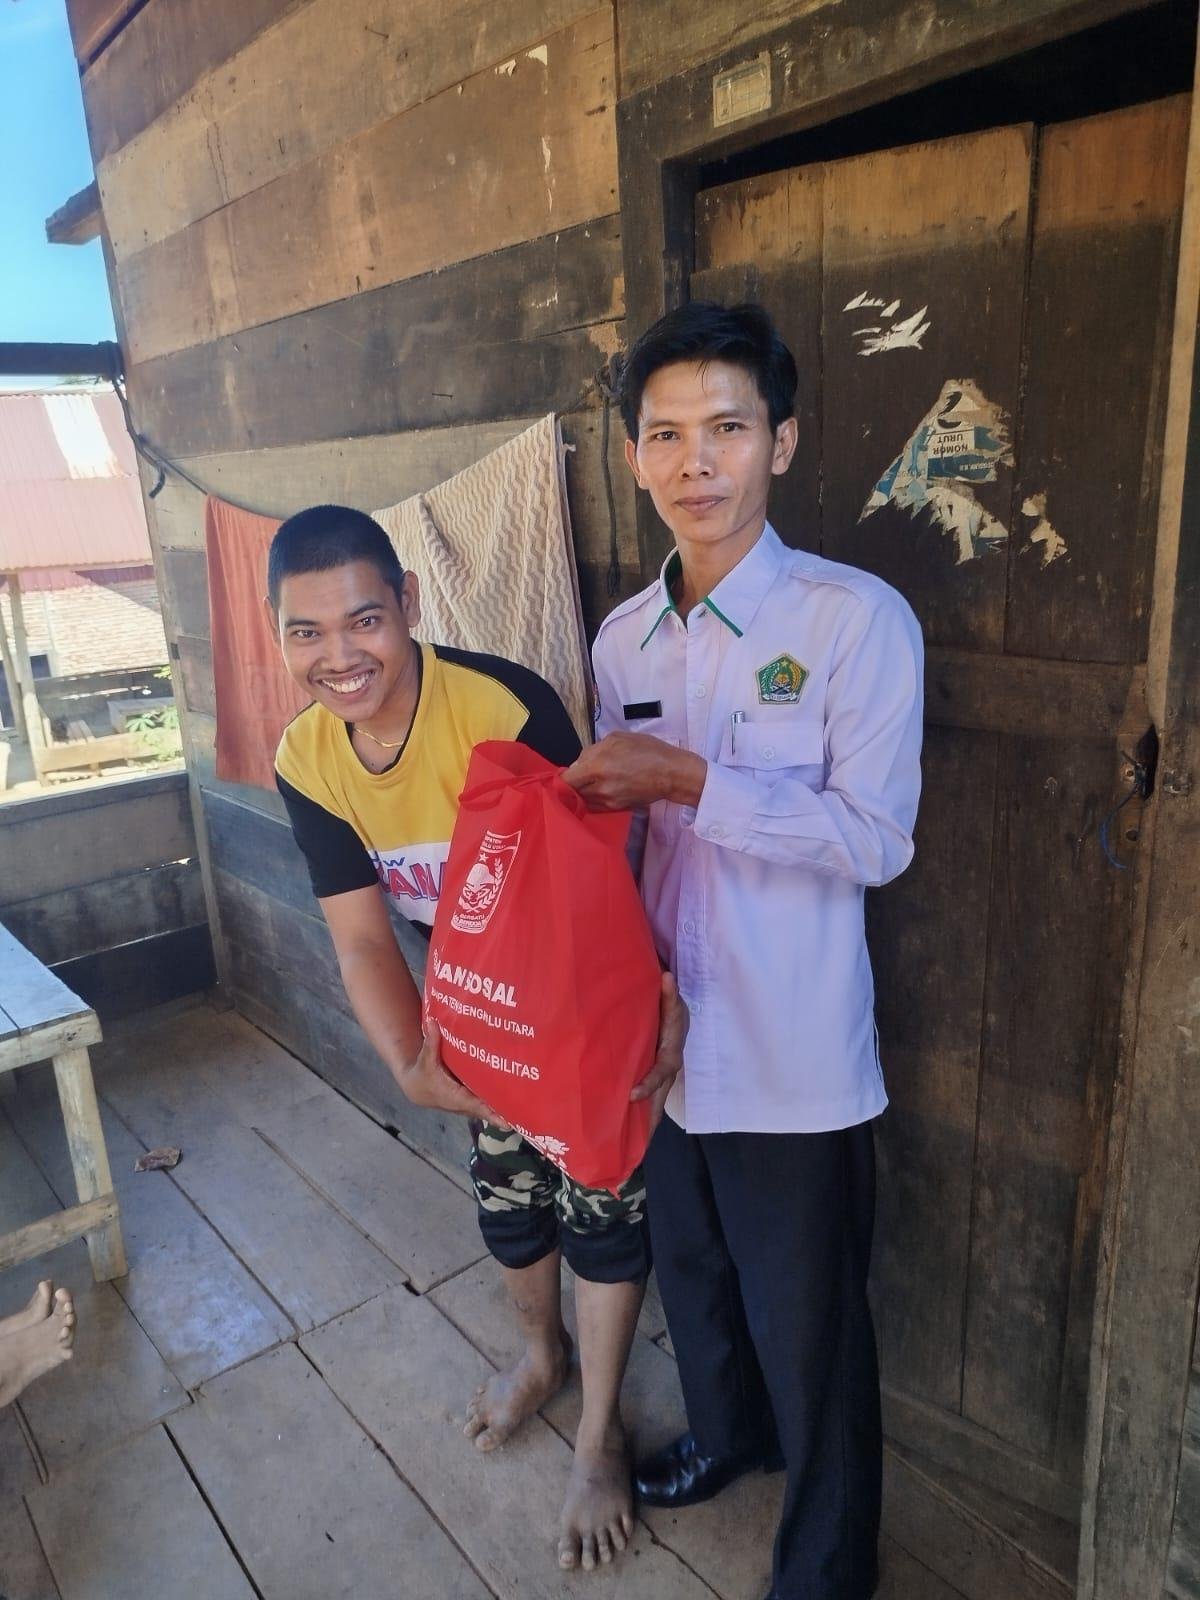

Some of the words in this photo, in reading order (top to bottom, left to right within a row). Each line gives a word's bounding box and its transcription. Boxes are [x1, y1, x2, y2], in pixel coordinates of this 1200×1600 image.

[938, 433, 964, 443] URUT
[933, 444, 968, 455] NOMOR
[503, 1019, 535, 1038] UTARA
[469, 1044, 540, 1081] DISABILITAS
